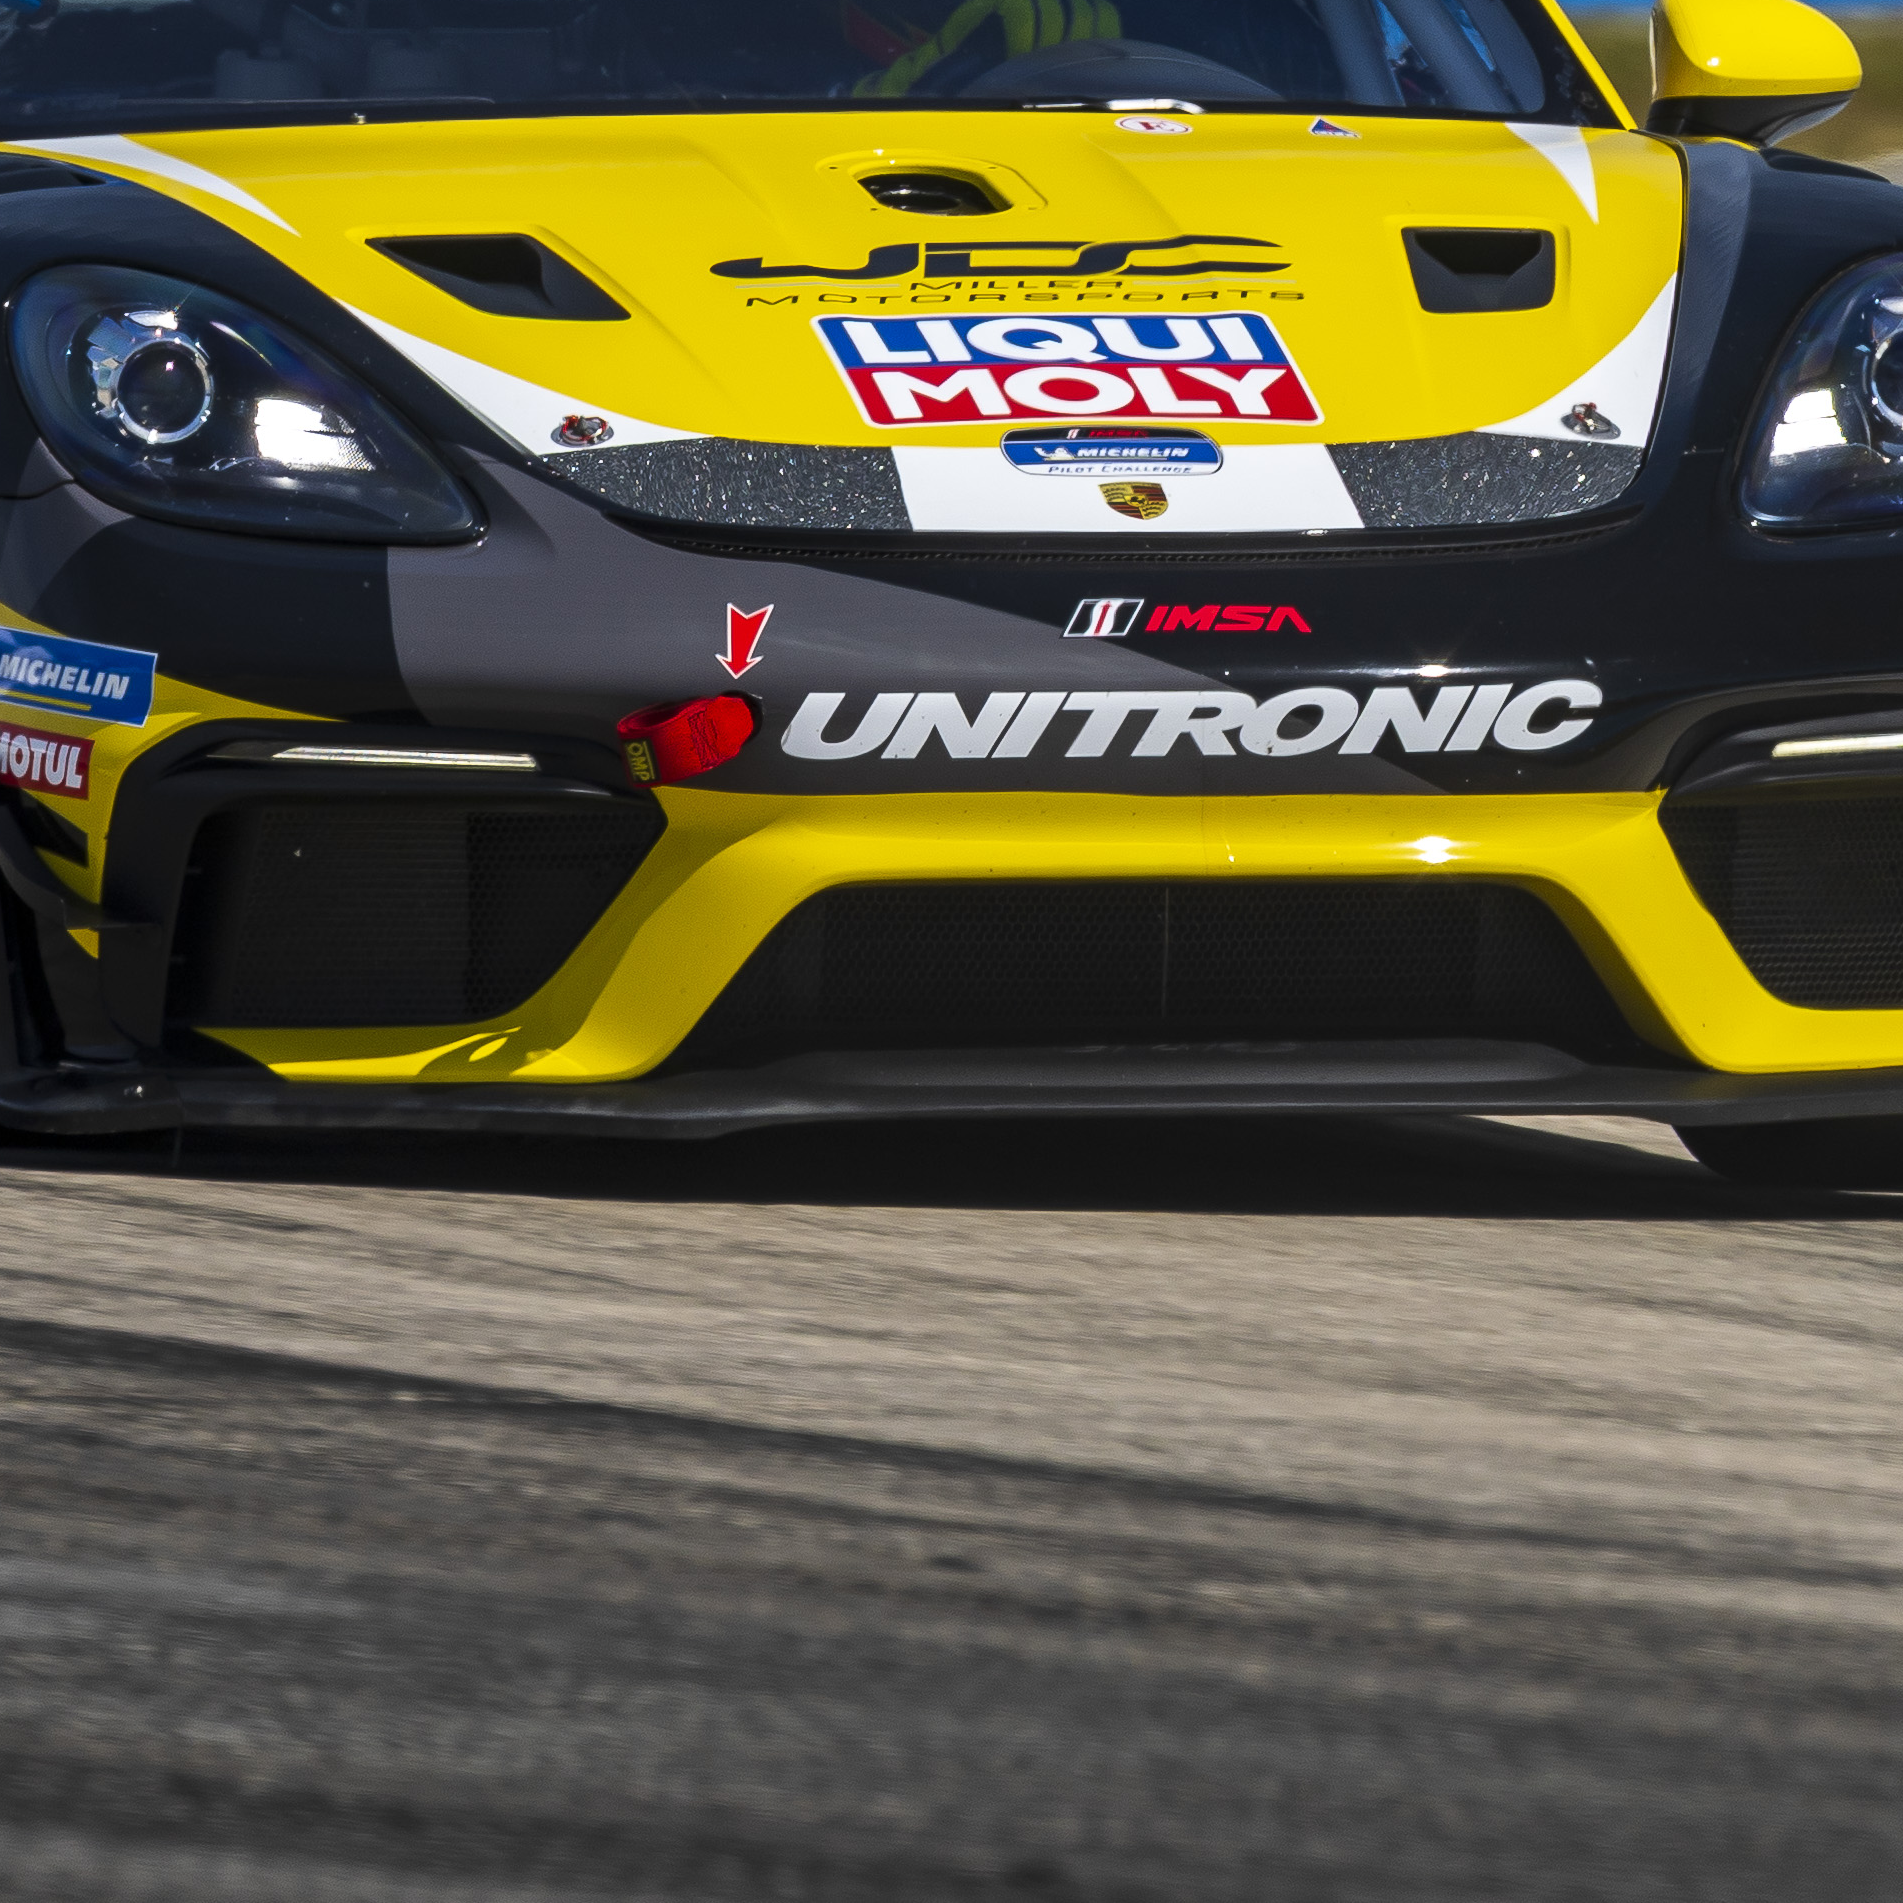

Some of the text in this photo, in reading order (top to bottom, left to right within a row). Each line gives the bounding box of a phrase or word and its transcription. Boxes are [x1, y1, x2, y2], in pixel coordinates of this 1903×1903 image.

[746, 289, 1304, 308] MOTORSPORTS
[910, 280, 1123, 291] MILLER
[841, 316, 1263, 364] LIQUI
[870, 366, 1289, 420] MOLY
[1076, 447, 1190, 458] MICHELIN
[1048, 464, 1194, 474] PILOT CHALLENGE
[1145, 604, 1313, 634] IMSA
[781, 679, 1604, 761] UNITRONIC
[626, 741, 651, 782] OMP
